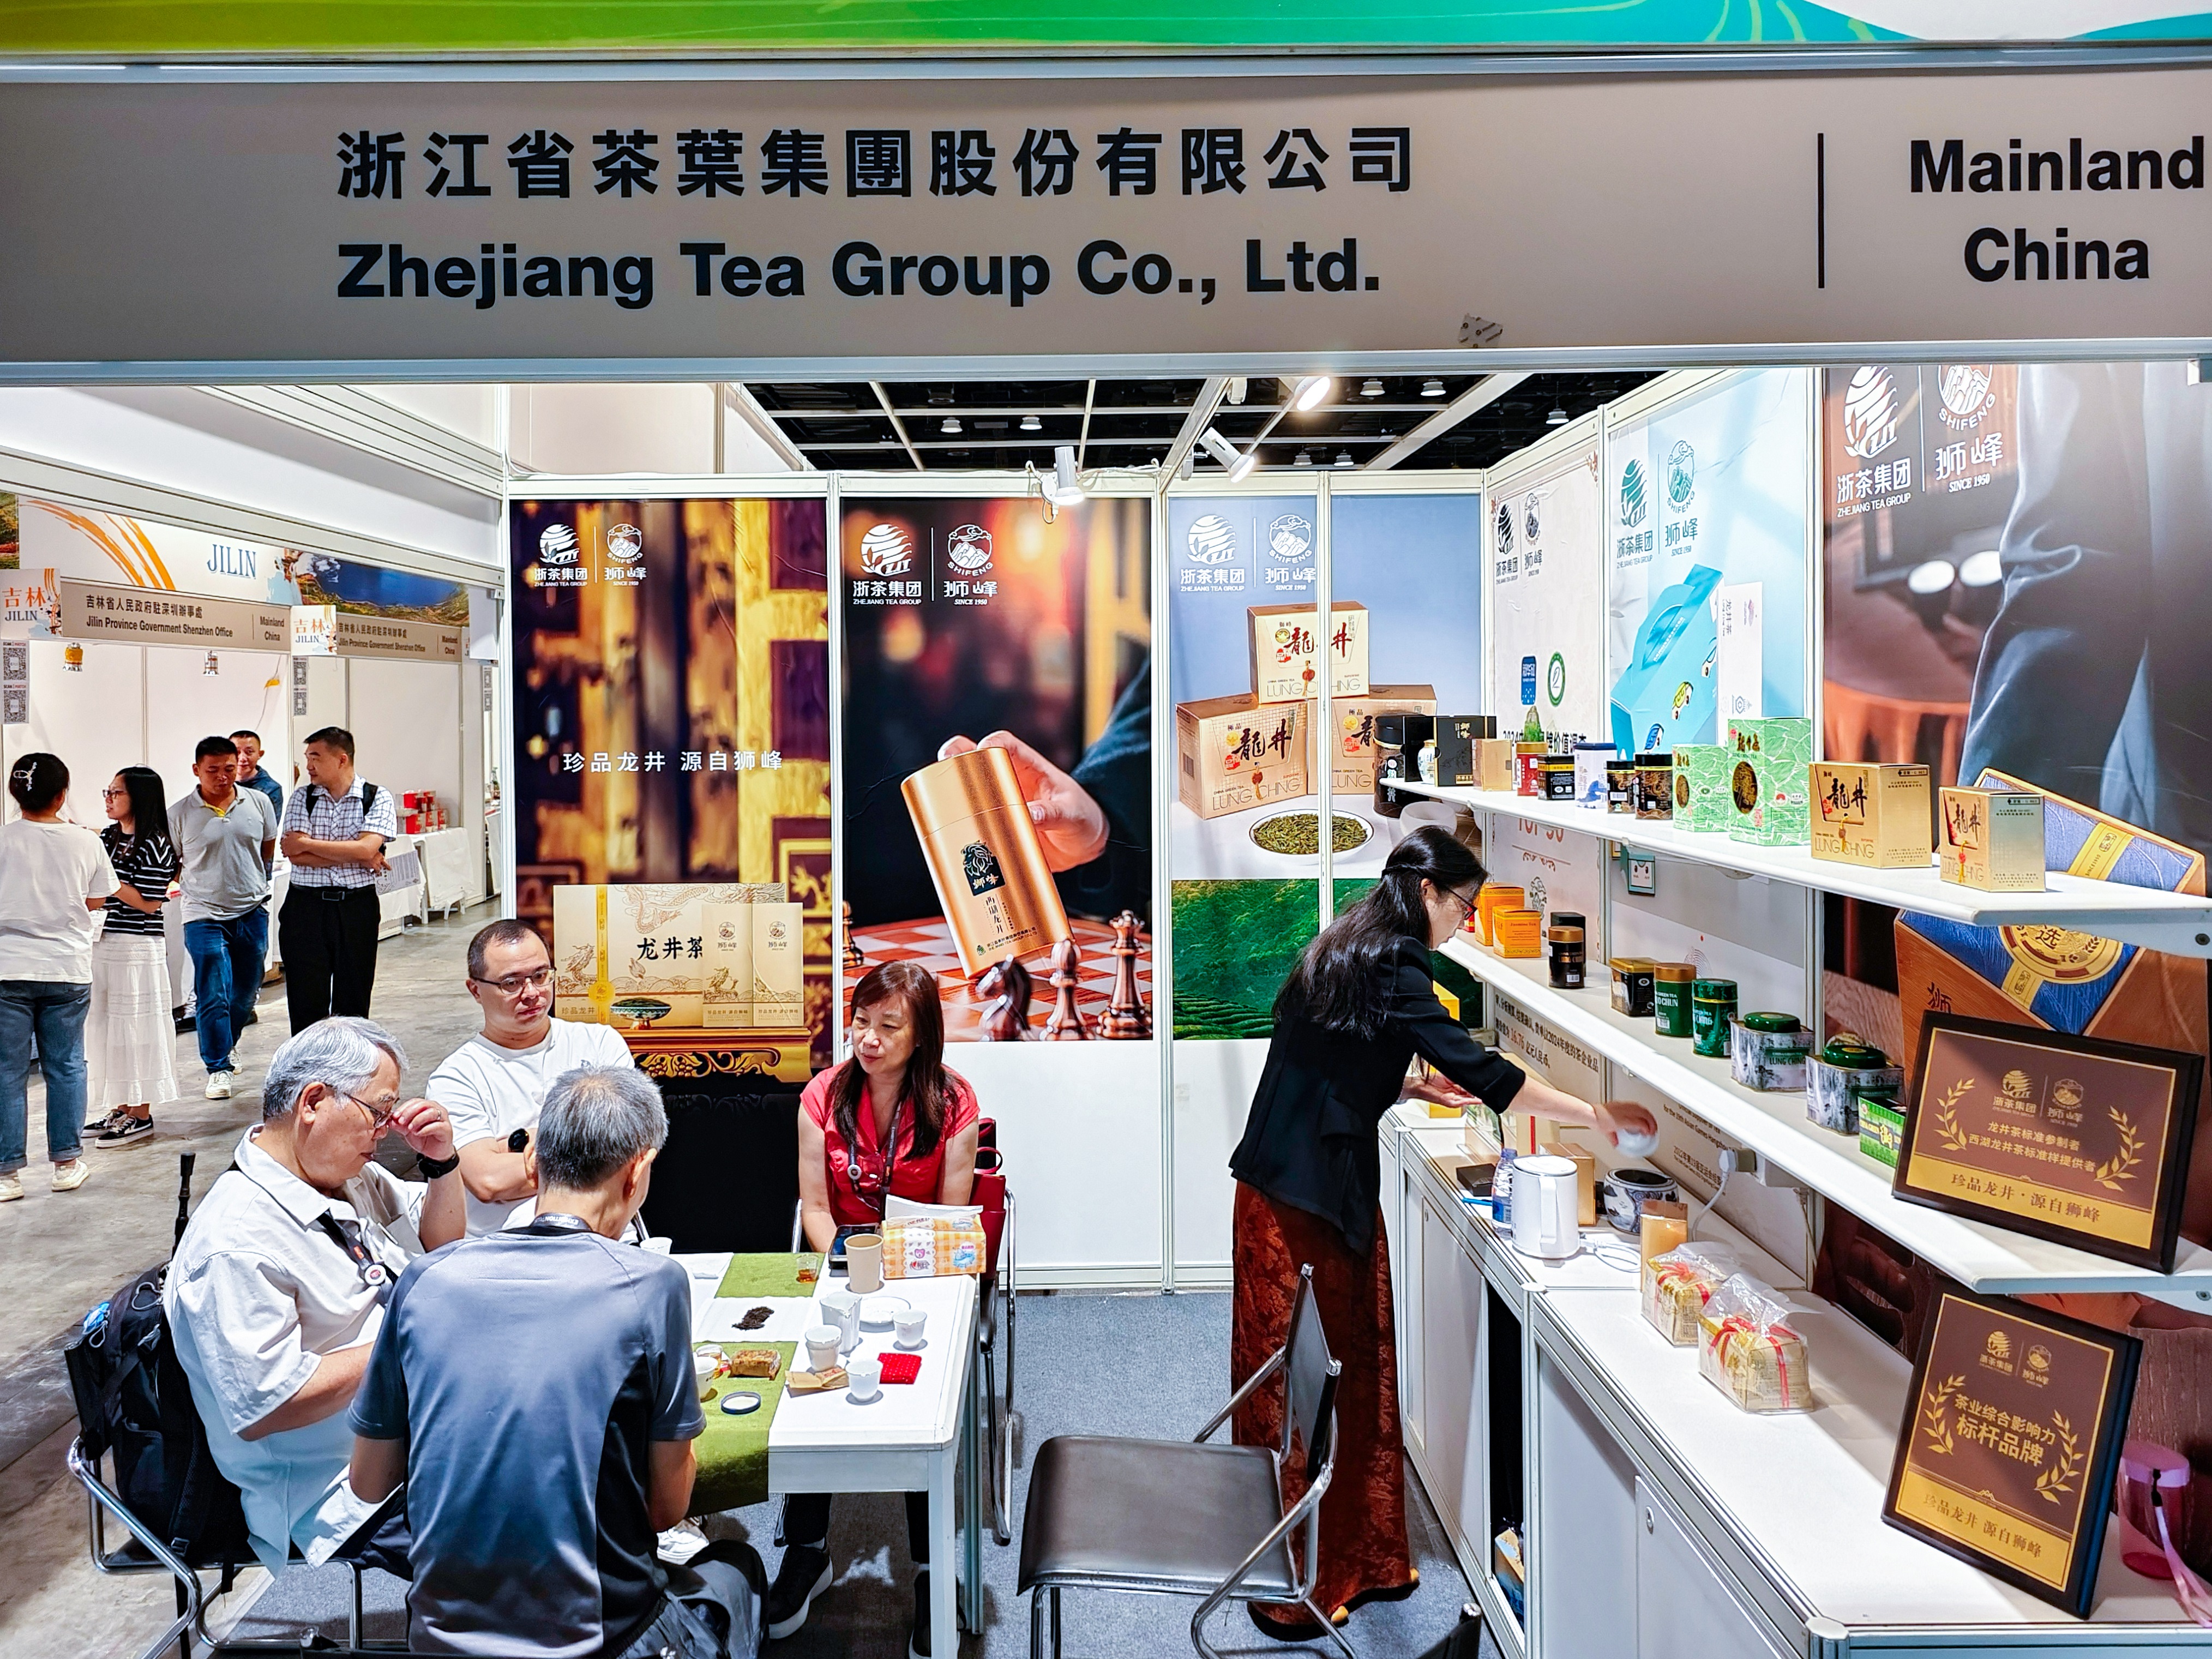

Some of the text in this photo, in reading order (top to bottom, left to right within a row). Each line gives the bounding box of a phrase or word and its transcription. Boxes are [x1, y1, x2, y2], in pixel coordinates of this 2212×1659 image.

[336, 127, 1410, 199] 浙江省茶葉集團股份有限公司
[1910, 135, 2204, 193] Mainland
[1964, 227, 2150, 282] China
[337, 238, 1379, 309] Zhejiang Tea Group Co., Ltd.
[1939, 393, 1995, 431] SHIFENG
[1936, 432, 2003, 480] 狮峰
[1836, 458, 1910, 504] 浙茶集团
[1949, 473, 1990, 492] SINCE 1950
[1667, 491, 1695, 514] SHIFENG
[1837, 492, 1911, 518] ZHEJIANG TEA GROUP
[1665, 518, 1698, 547] 狮峰
[1617, 530, 1653, 558] 浙茶集团
[207, 544, 256, 579] JILIN
[607, 552, 643, 564] SHIFENG
[1269, 549, 1312, 563] SHIFENG
[1496, 557, 1518, 577] 浙茶集团
[534, 568, 587, 580] 浙茶集团
[604, 567, 647, 580] 狮峰
[947, 562, 993, 576] SHIFENG
[1181, 568, 1245, 584] 浙茶集团
[1265, 568, 1316, 584] 狮峰
[2, 586, 46, 608] 吉林
[853, 581, 922, 597] 浙茶集团
[943, 581, 997, 597] 狮峰
[5, 610, 38, 621] JILIN
[86, 594, 202, 619] 吉林省人民政府駐深圳辦事處
[87, 616, 233, 637] Jilin Province Government Shenzhen Office
[260, 616, 284, 628] Mainland
[294, 618, 326, 633] 吉林
[265, 630, 280, 641] China
[296, 635, 320, 643] JILIN
[349, 639, 368, 648] Province
[369, 640, 394, 650] Government
[395, 642, 413, 651] Shenzhen
[1267, 682, 1303, 698] LUNG
[1231, 718, 1292, 761] 龍井
[563, 750, 783, 773] 珍品龙井 源自狮峰
[1213, 778, 1300, 811] LUNG CHING
[1826, 777, 1867, 818] 龍井
[1953, 803, 1980, 843] 龍井
[1815, 837, 1840, 853] LUNG
[1843, 841, 1874, 858] CHING
[637, 936, 702, 960] 龙井茶
[2036, 929, 2061, 949] 选
[1927, 982, 1951, 1014] 狮
[1769, 1056, 1805, 1065] LUNG CHING
[1993, 1096, 2036, 1114] 浙茶集团
[2047, 1108, 2083, 1122] 狮峰
[1695, 1124, 1708, 1139] Games
[1987, 1121, 2080, 1152] 龙井茶标准参制者
[1968, 1134, 2096, 1173] 西湖龙井茶标准样提供者
[1955, 1394, 2055, 1446] 茶业综合影响力
[1956, 1414, 2045, 1468] 标杆品牌
[1923, 1492, 1978, 1529] 珍品龙井
